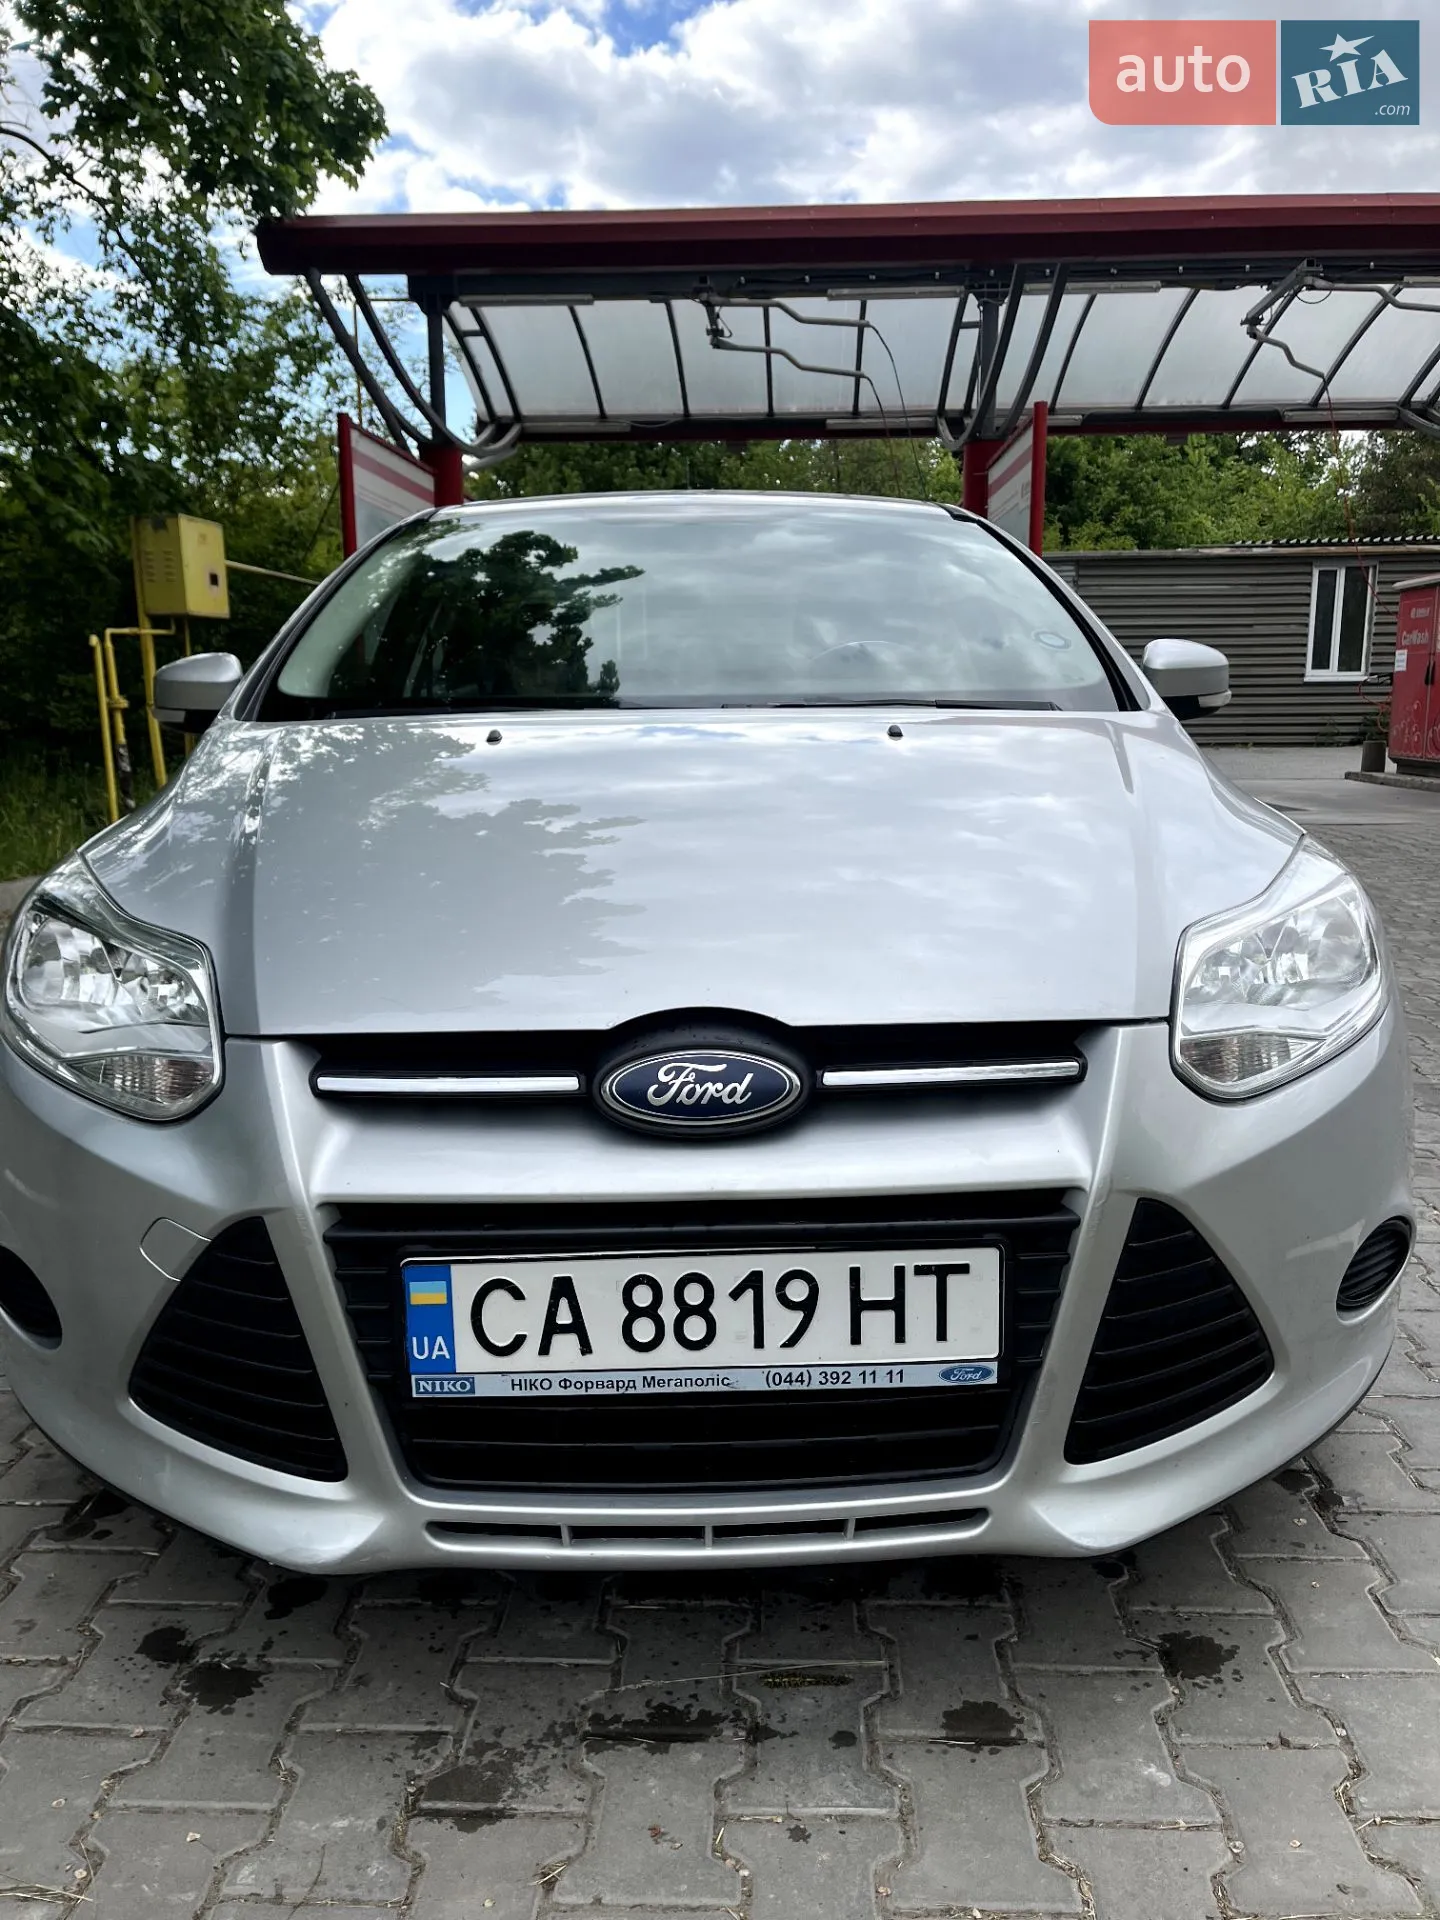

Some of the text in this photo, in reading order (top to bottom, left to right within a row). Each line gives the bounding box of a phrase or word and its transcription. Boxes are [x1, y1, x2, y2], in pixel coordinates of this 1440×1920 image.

[646, 1062, 754, 1106] Ford
[470, 1262, 971, 1357] CA 8819 HT
[411, 1335, 451, 1360] UA
[510, 1374, 731, 1392] НІКО Форвард Мегаполіс
[765, 1368, 905, 1388] (044) 392 11 11
[949, 1367, 982, 1382] Ford
[417, 1379, 471, 1392] NIKO
